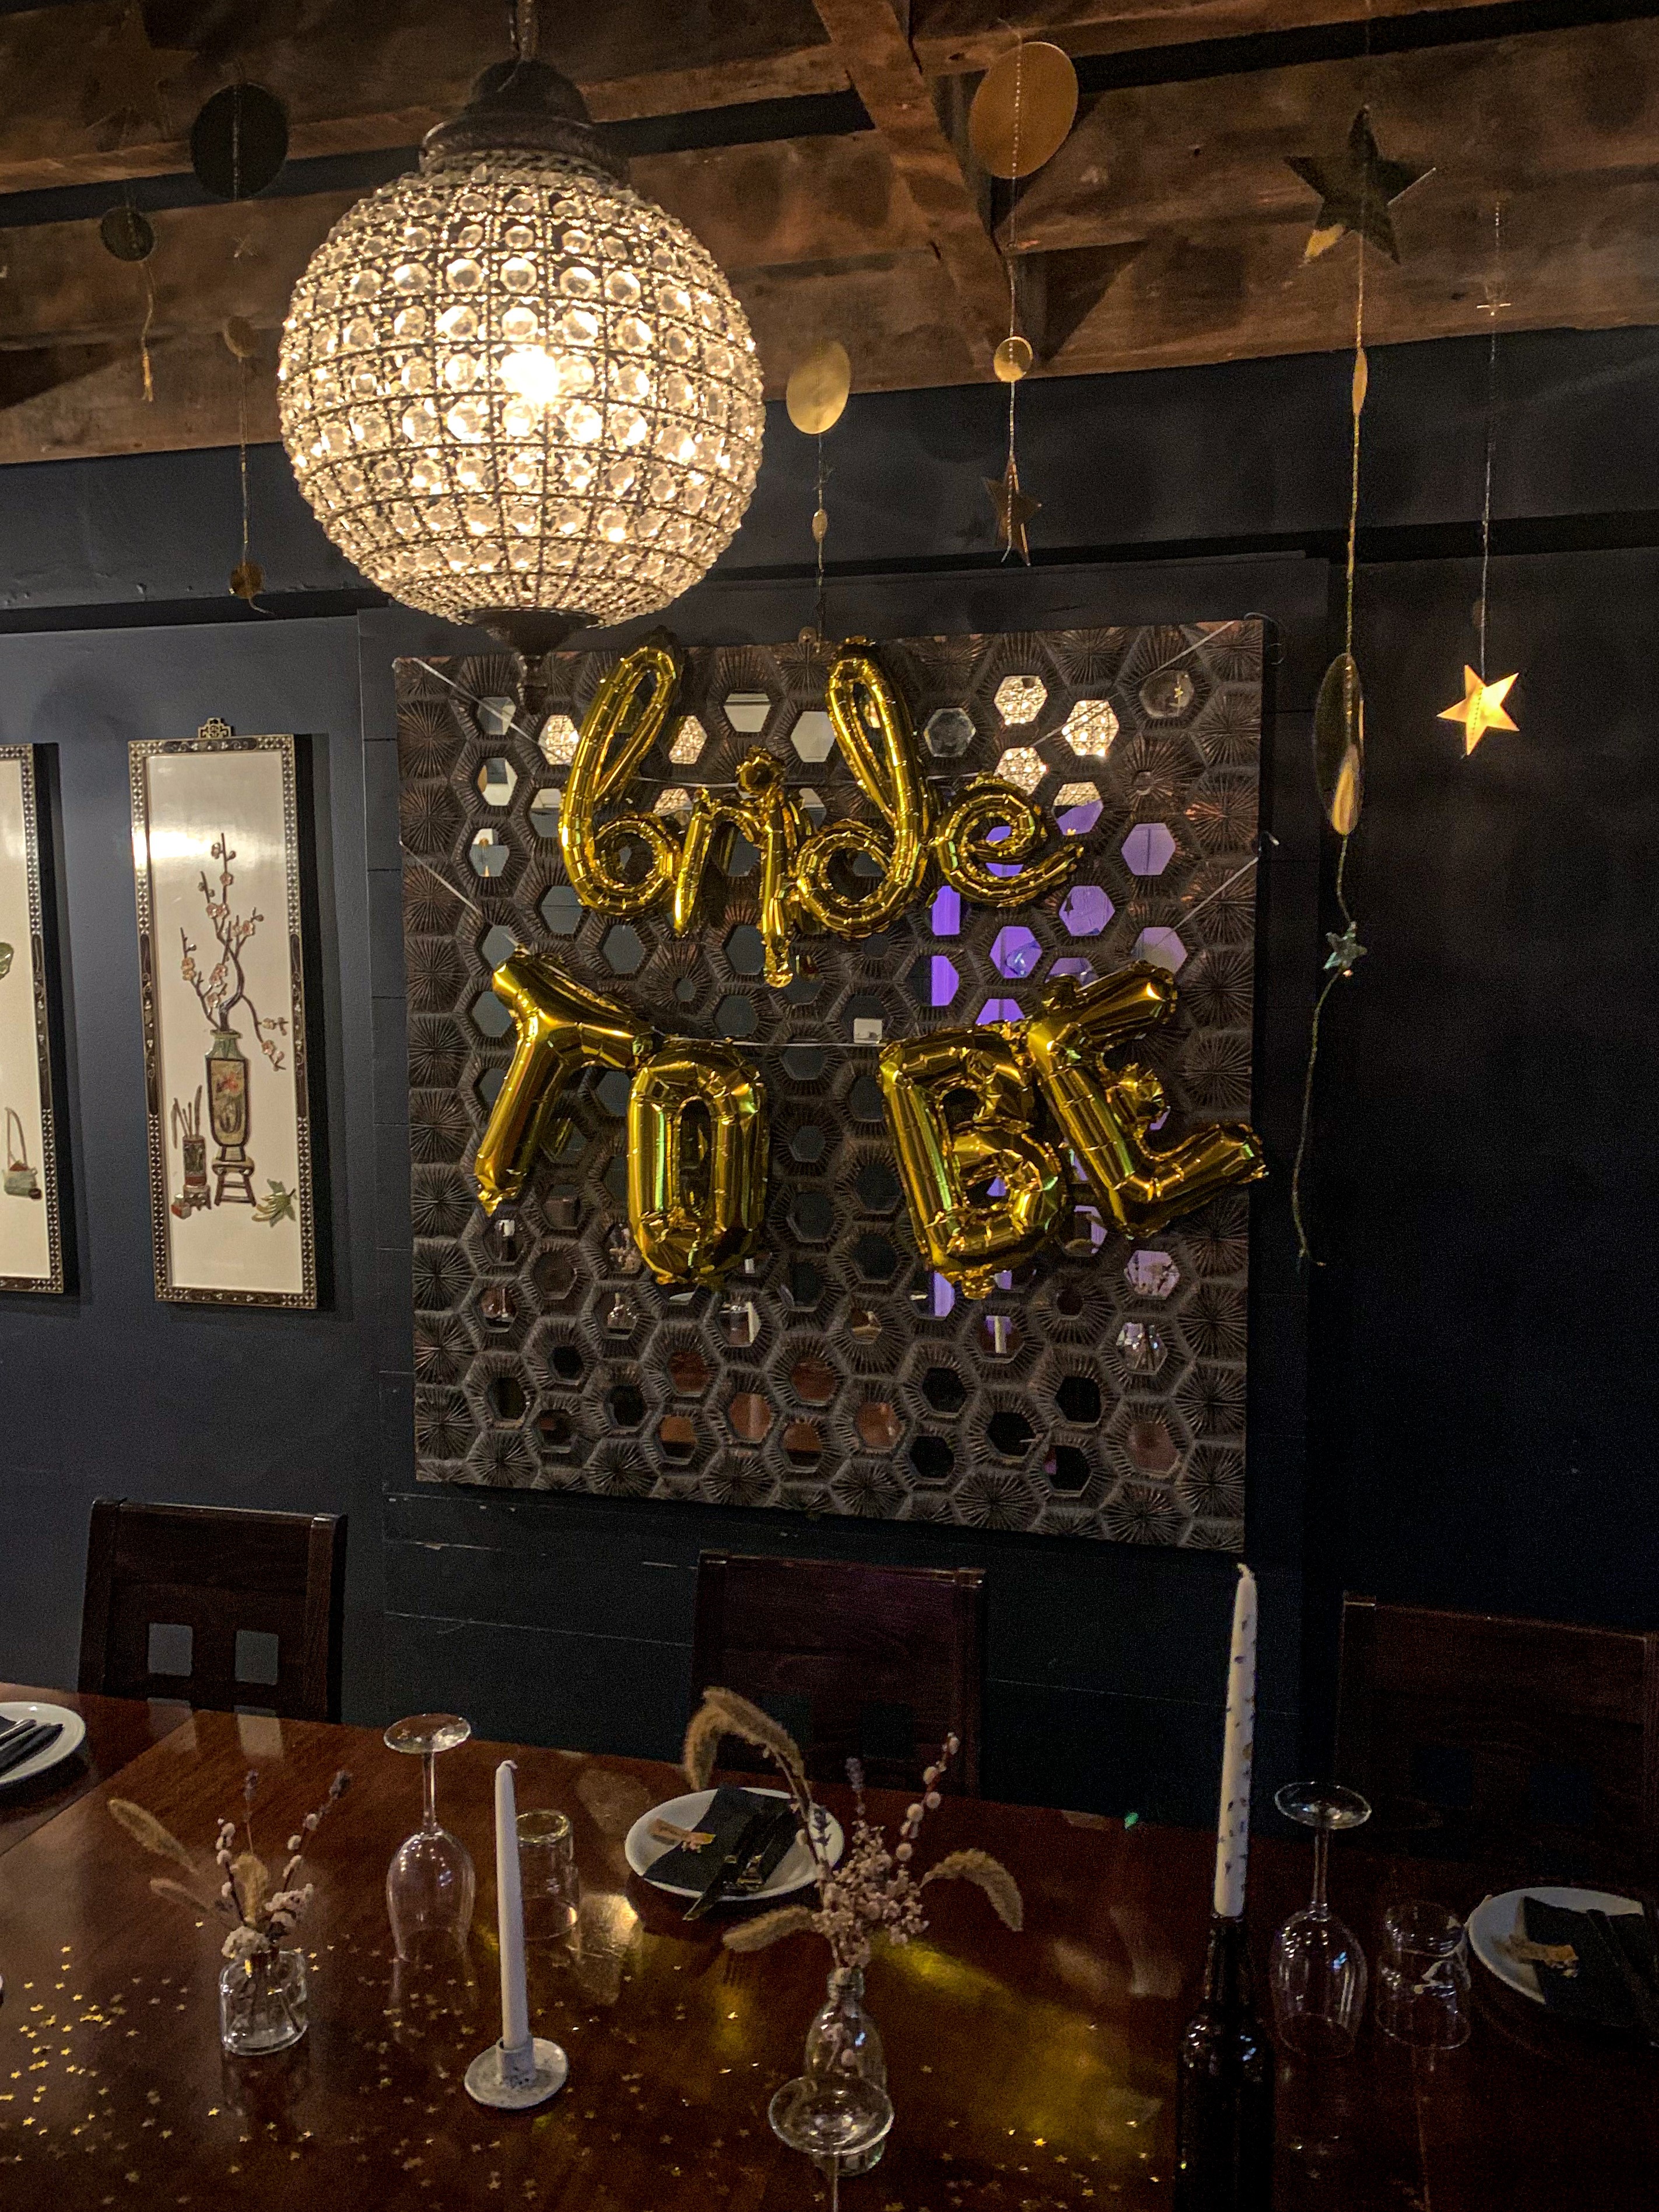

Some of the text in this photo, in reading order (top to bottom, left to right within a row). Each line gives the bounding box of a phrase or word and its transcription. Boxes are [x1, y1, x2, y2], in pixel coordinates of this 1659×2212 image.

[557, 638, 1086, 986] bride
[475, 949, 1268, 1299] TO BE
